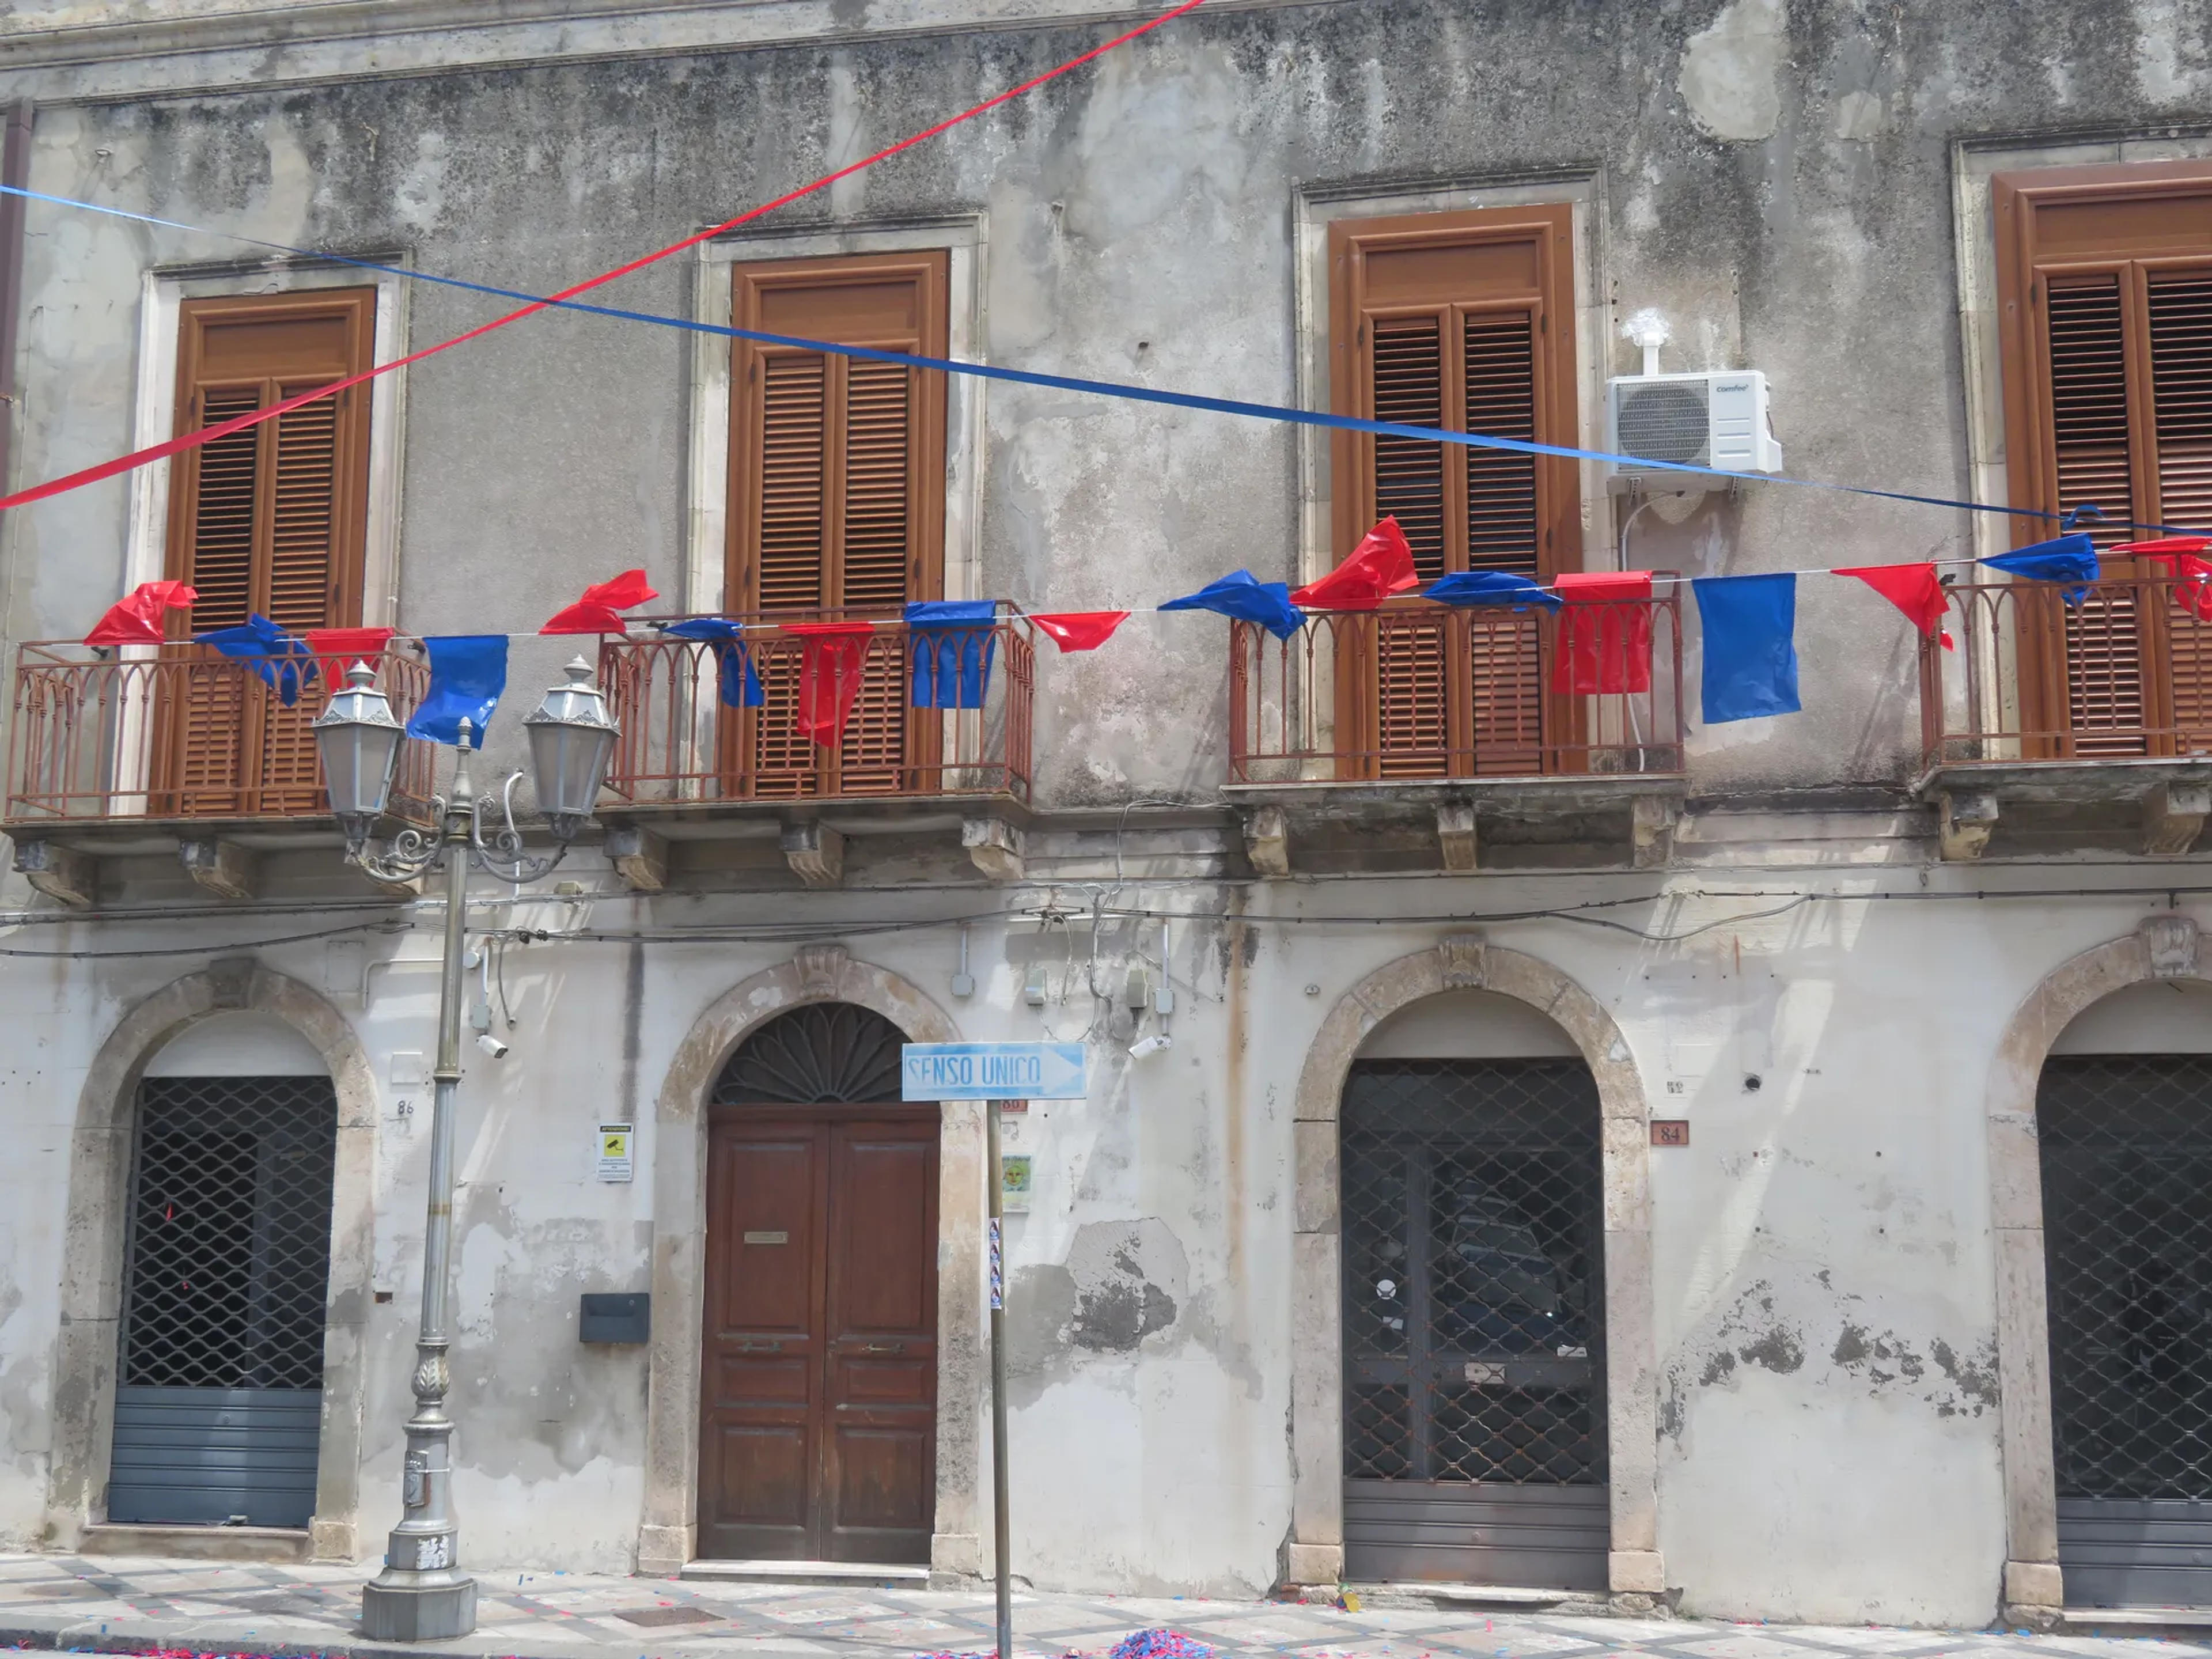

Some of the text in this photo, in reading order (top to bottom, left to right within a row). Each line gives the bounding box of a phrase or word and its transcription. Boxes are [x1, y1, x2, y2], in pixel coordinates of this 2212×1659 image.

[982, 1056, 1041, 1085] UNICO
[397, 1100, 414, 1115] 86
[1661, 1126, 1680, 1142] 84
